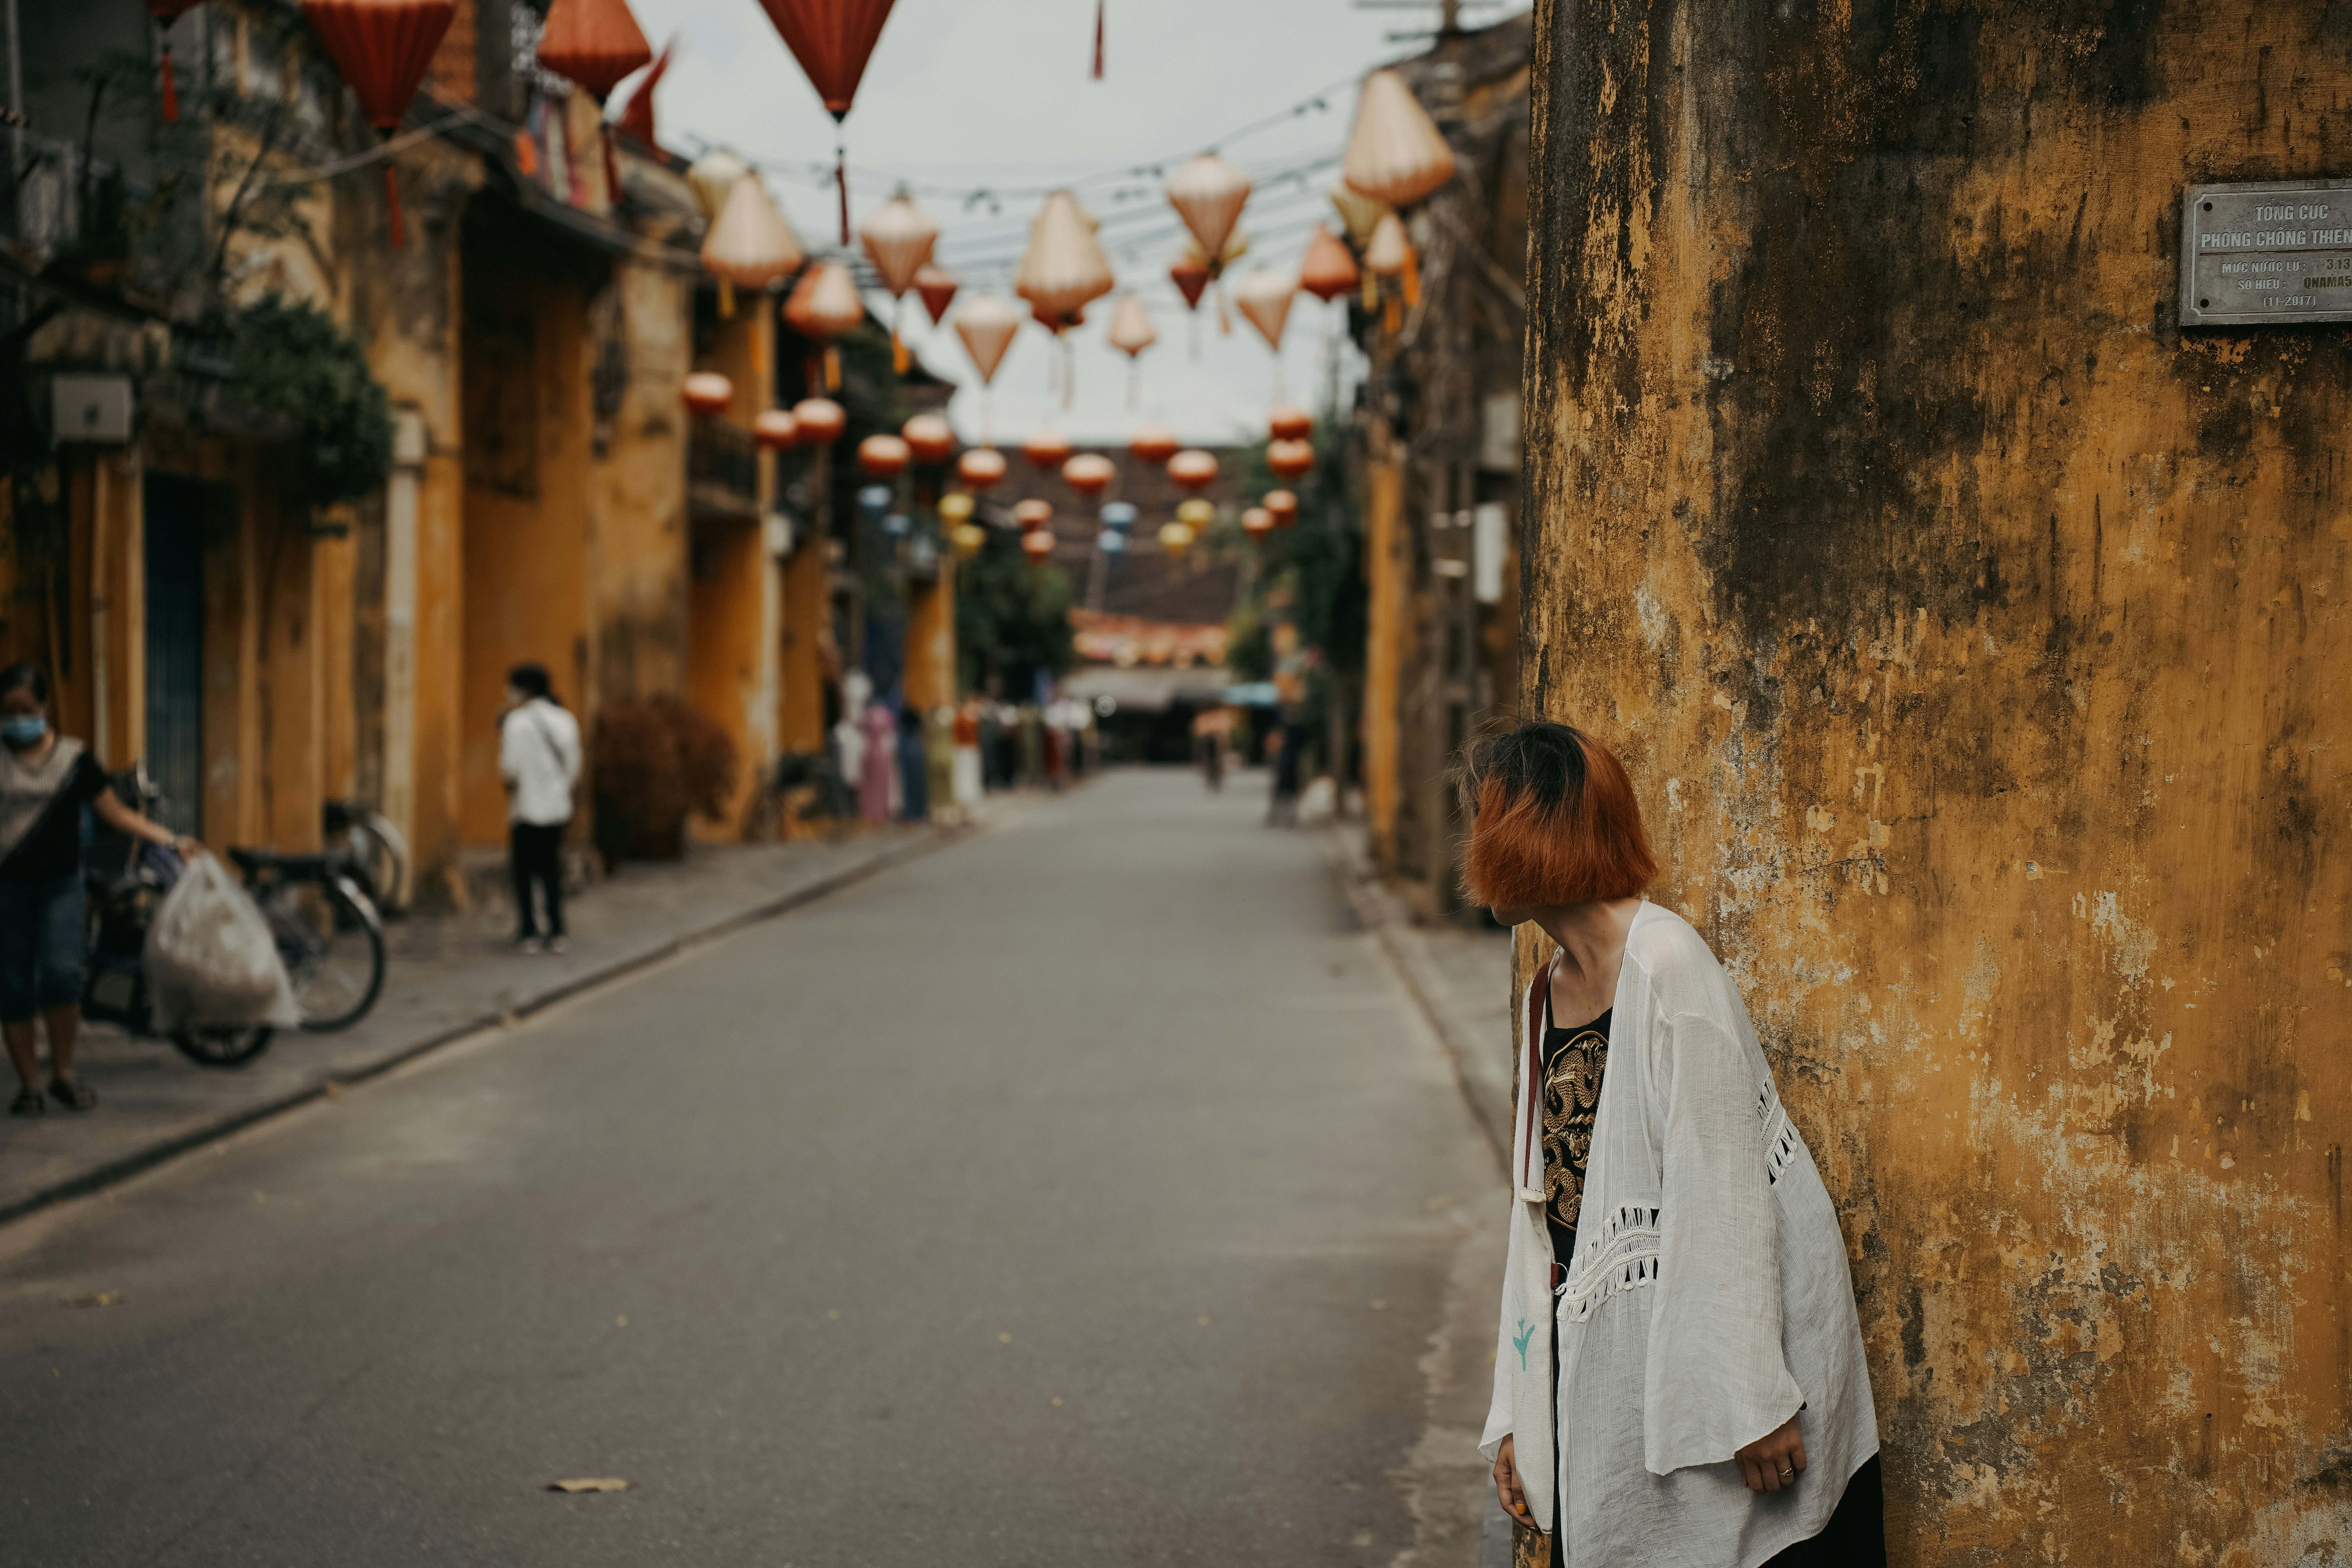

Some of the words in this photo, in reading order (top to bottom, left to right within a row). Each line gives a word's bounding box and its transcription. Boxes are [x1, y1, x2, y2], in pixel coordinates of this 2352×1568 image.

[2299, 203, 2328, 223] CỤC
[2201, 227, 2251, 248] PHÒNG
[2256, 224, 2306, 246] CHỐNG
[2310, 224, 2352, 245] THIÊN
[2221, 261, 2248, 275] MỰC
[2251, 257, 2283, 273] NƯỚC
[2327, 258, 2350, 270] 3.13
[2238, 274, 2252, 290] SỐ
[2255, 275, 2280, 291] HIỆU
[2263, 294, 2316, 307] (11-2017)
